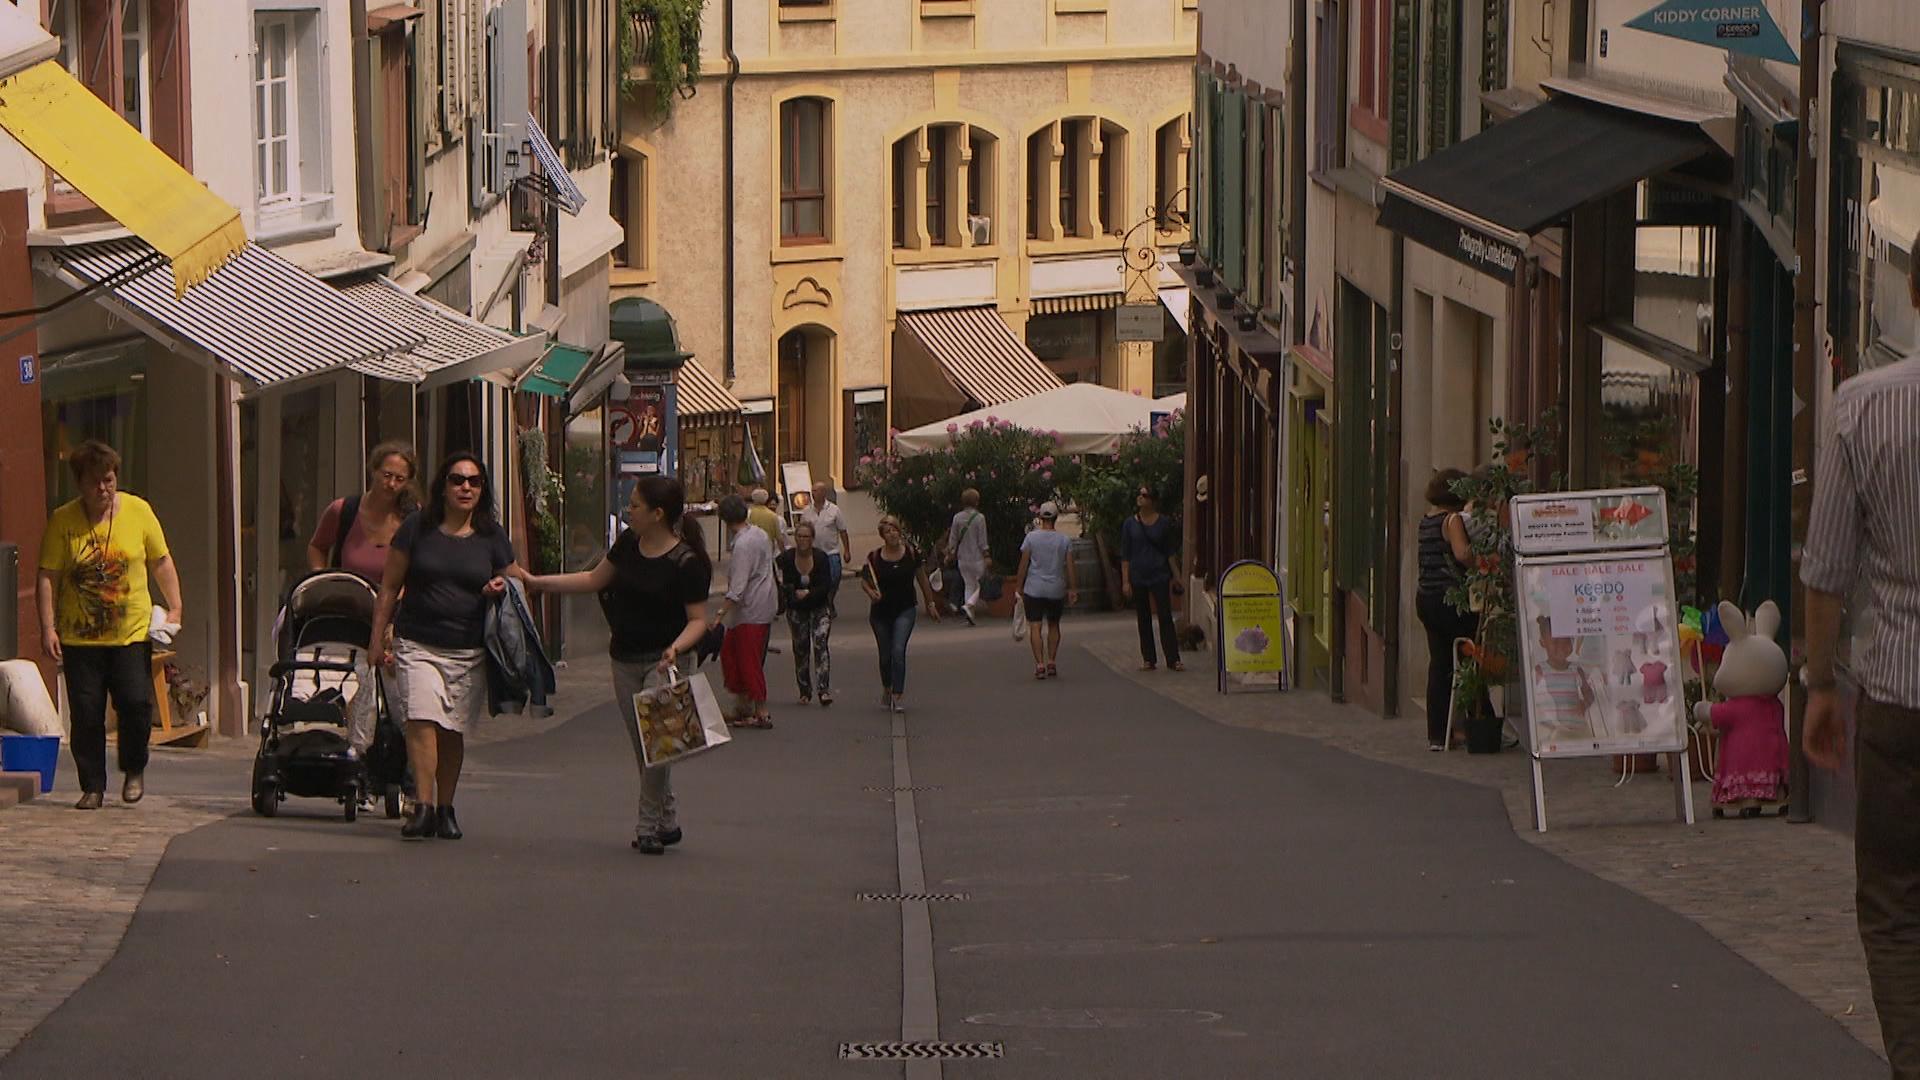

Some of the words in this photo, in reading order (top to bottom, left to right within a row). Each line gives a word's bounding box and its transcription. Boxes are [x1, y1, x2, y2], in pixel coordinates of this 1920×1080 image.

[1653, 9, 1699, 24] KIDDY
[1701, 7, 1761, 20] CORNER
[1552, 567, 1579, 576] SALE
[1584, 564, 1612, 575] SALE
[1617, 563, 1646, 573] SALE
